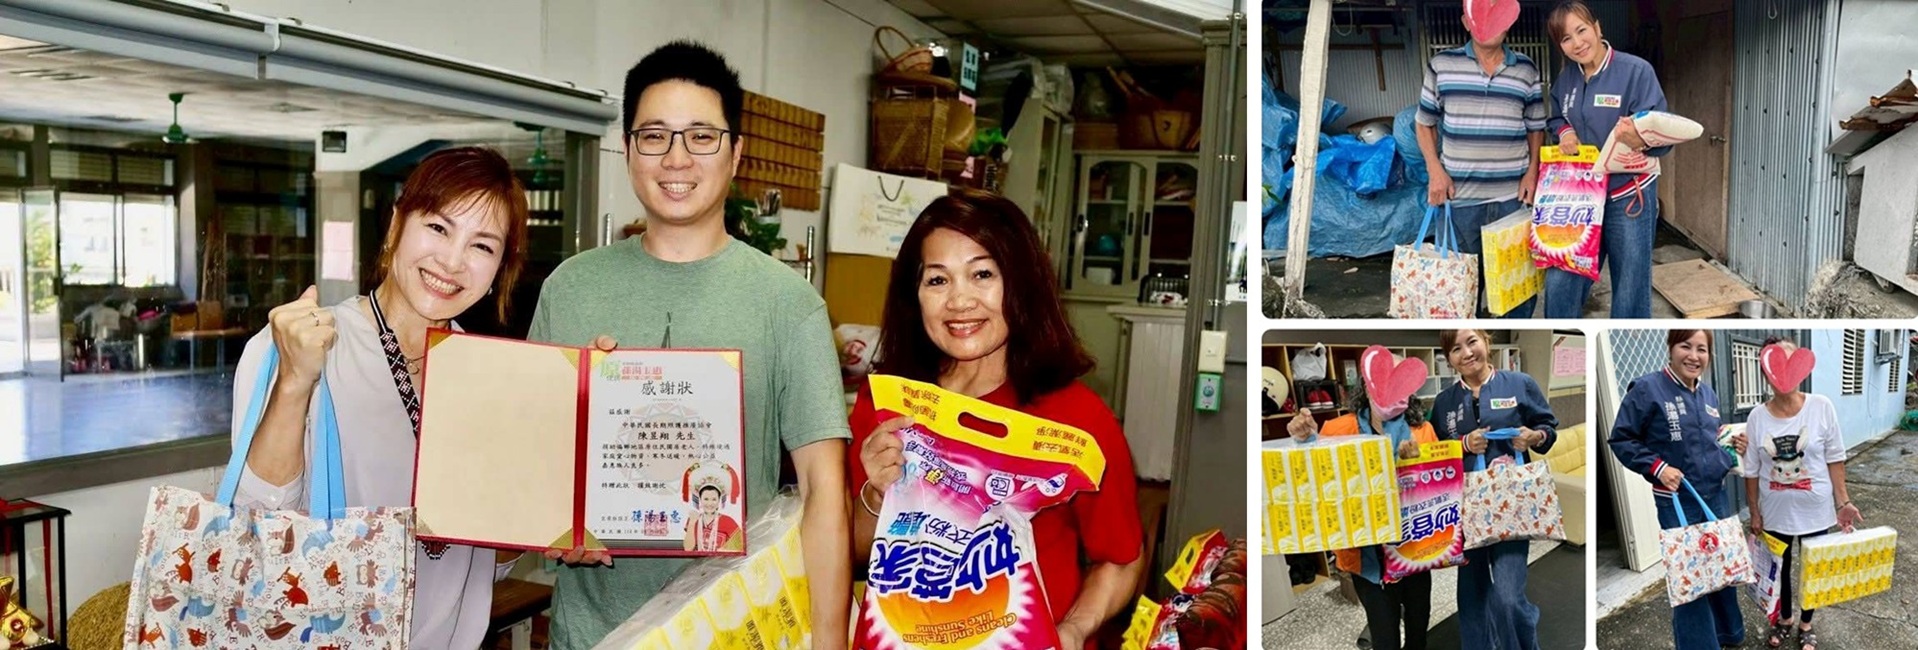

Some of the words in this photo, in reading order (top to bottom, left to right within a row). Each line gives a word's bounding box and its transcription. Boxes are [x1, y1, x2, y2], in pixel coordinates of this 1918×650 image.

[1532, 203, 1595, 227] 妙管家
[640, 381, 694, 396] 感謝狀
[637, 431, 670, 441] 陳昱翔
[675, 431, 696, 441] 先生
[867, 521, 1021, 599] 妙管家
[915, 619, 966, 633] Sunshine
[968, 609, 995, 626] Like
[976, 612, 1017, 635] Cleans
[902, 632, 948, 646] Freshens
[950, 625, 976, 643] and
